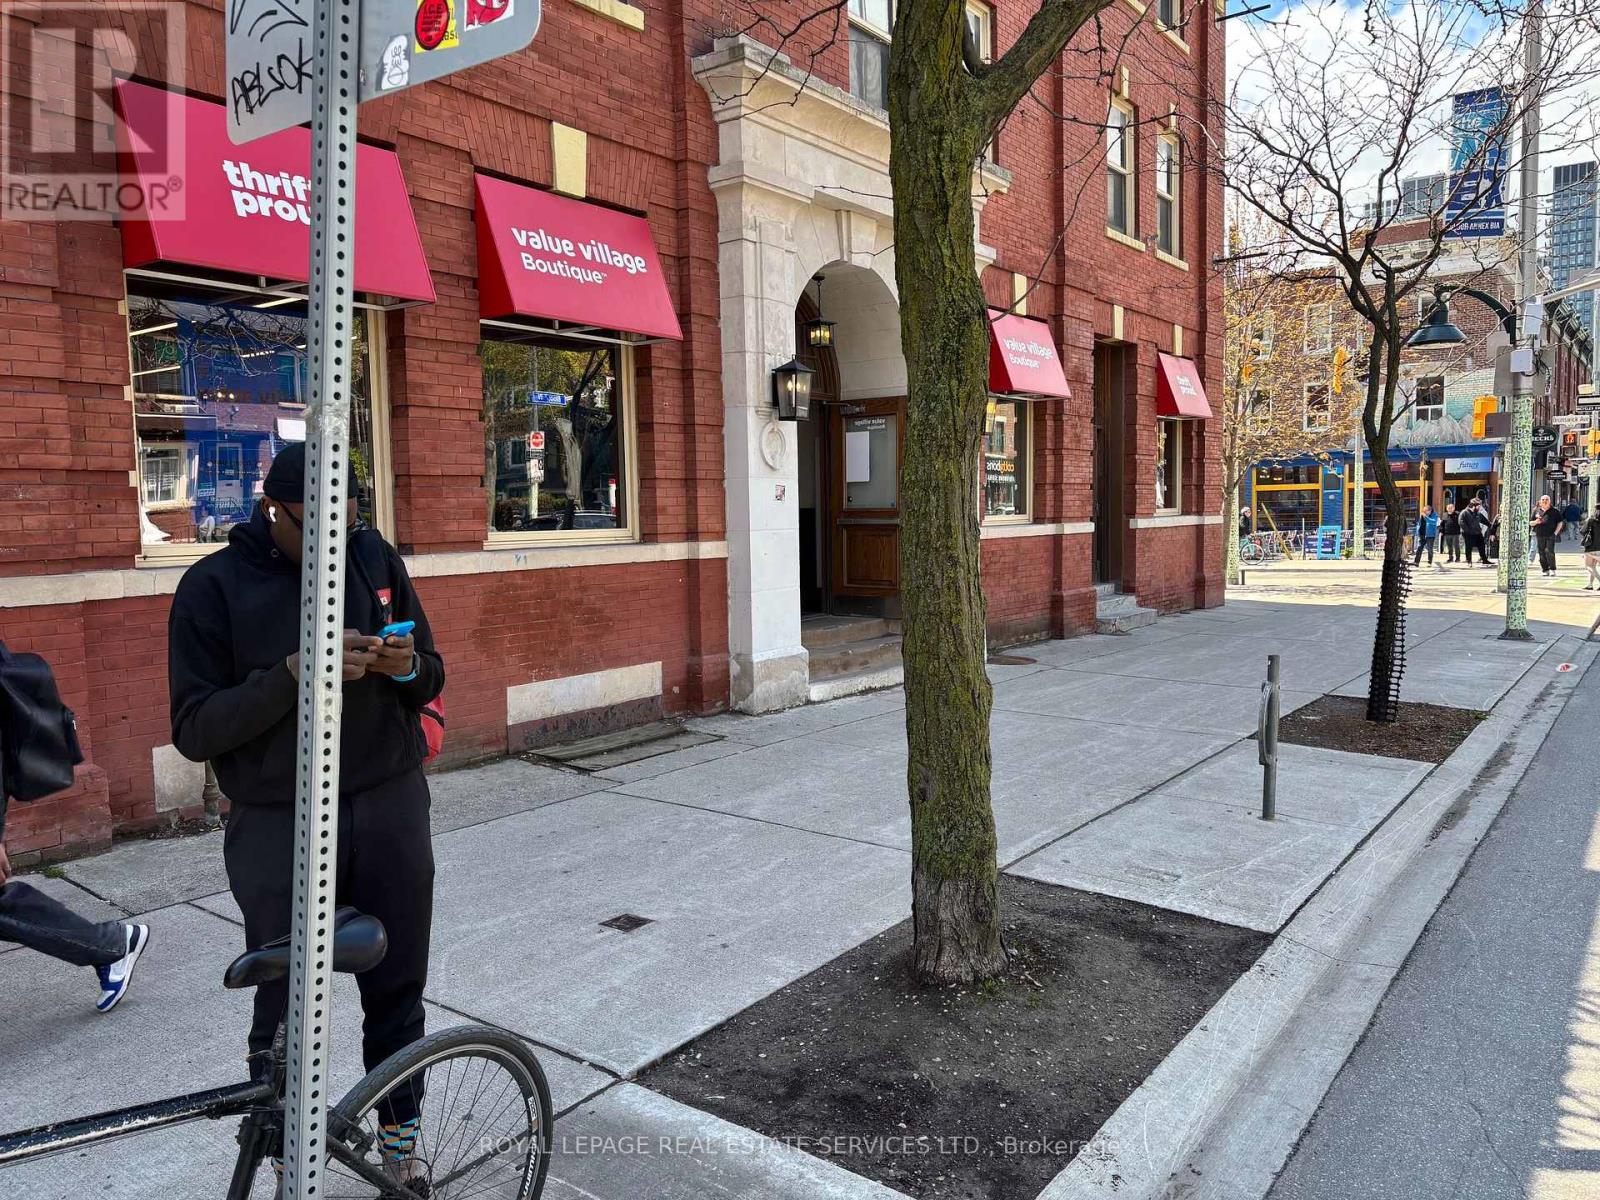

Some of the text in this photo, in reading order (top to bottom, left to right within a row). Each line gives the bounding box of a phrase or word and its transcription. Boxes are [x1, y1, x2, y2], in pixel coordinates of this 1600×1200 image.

[222, 159, 312, 201] thrif
[231, 189, 311, 226] prou
[511, 227, 648, 274] value village
[1513, 505, 1523, 573] ANNX
